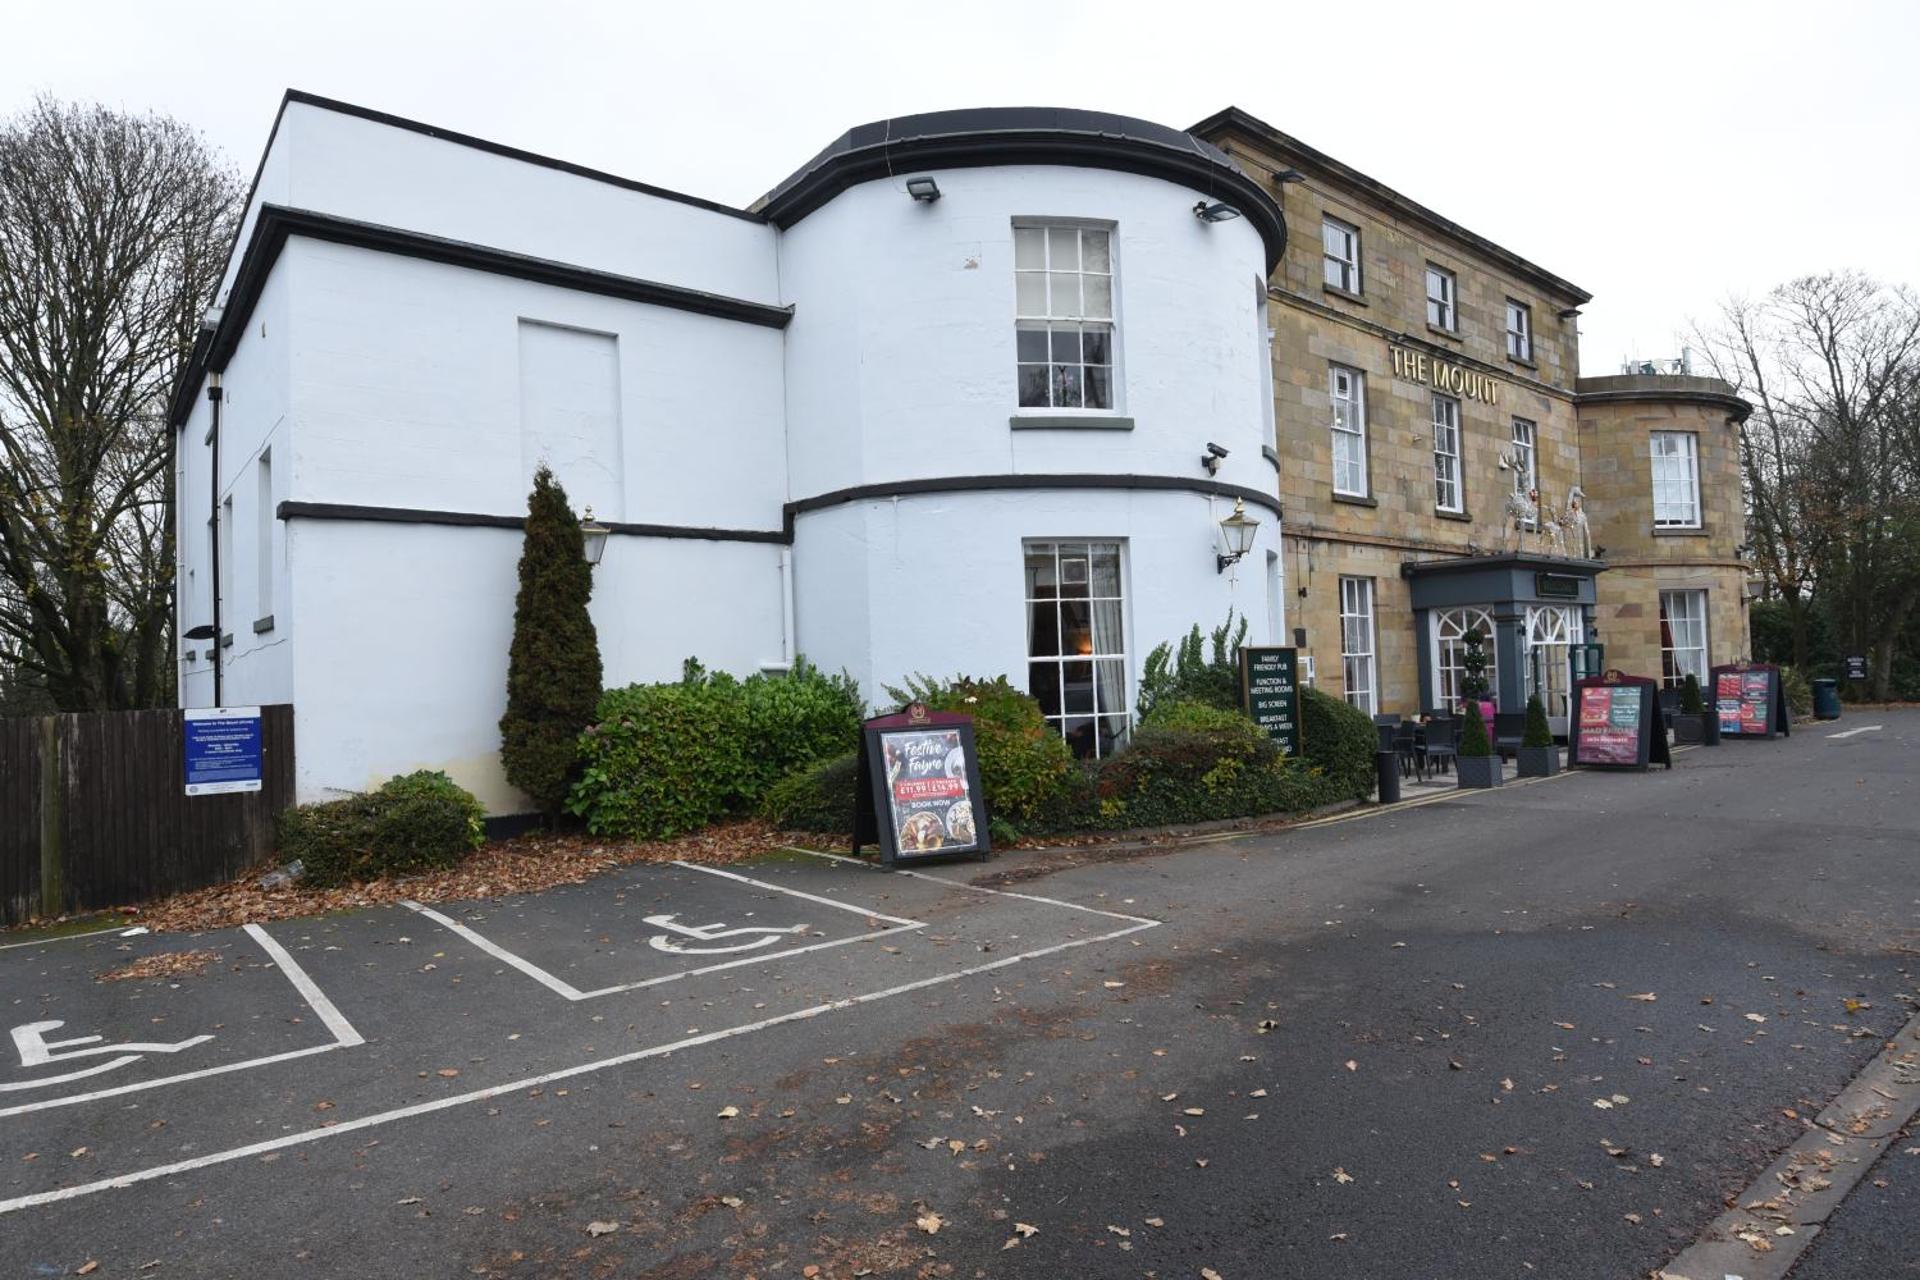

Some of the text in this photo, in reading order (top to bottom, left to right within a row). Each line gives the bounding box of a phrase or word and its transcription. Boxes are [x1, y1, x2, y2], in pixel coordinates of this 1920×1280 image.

[1389, 345, 1498, 405] THE MOUNT
[1253, 663, 1287, 671] FRIENDLY PUB
[1256, 678, 1282, 686] FUNCTION
[1258, 700, 1287, 709] BIG SCREEN
[1260, 714, 1287, 723] BREAKFAST
[1279, 722, 1293, 730] WEEK
[904, 739, 943, 758] Festive
[909, 756, 943, 775] Fayre
